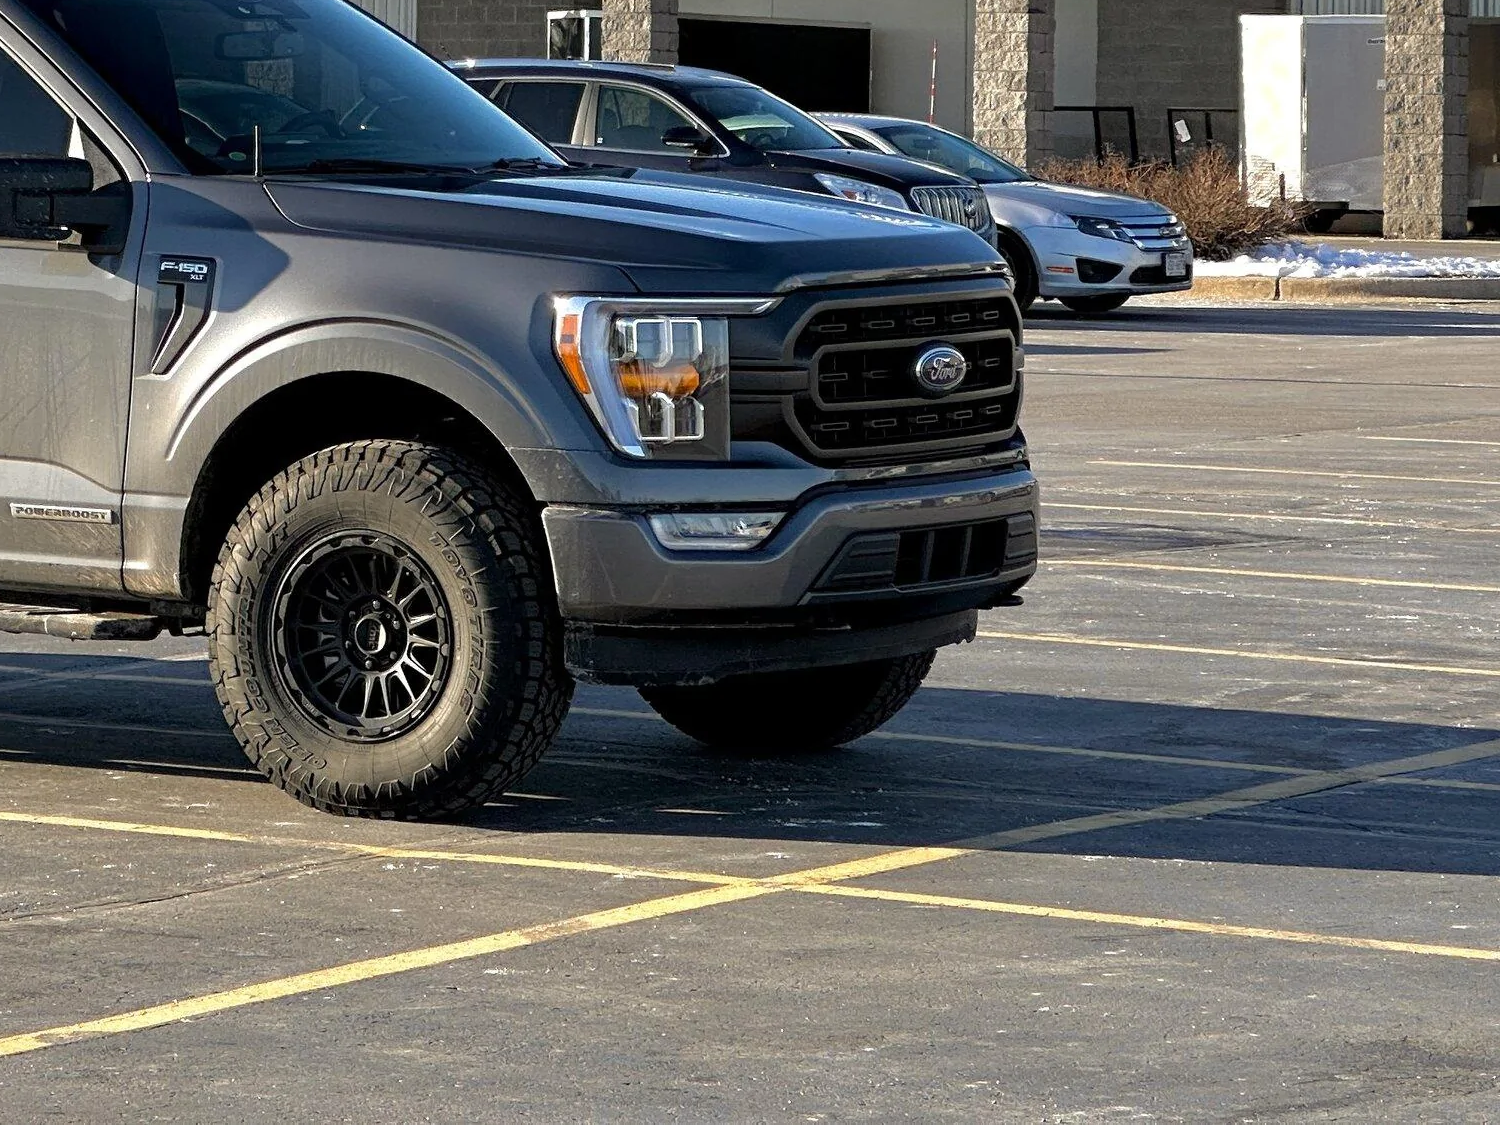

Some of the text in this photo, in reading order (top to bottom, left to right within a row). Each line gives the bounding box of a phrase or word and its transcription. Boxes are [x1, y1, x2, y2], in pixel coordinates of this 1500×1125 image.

[161, 262, 208, 273] F-150
[928, 357, 963, 380] Ford
[15, 506, 107, 520] POWERBOOST
[429, 531, 484, 716] TOYO TIRES
[264, 717, 328, 770] OPEN
